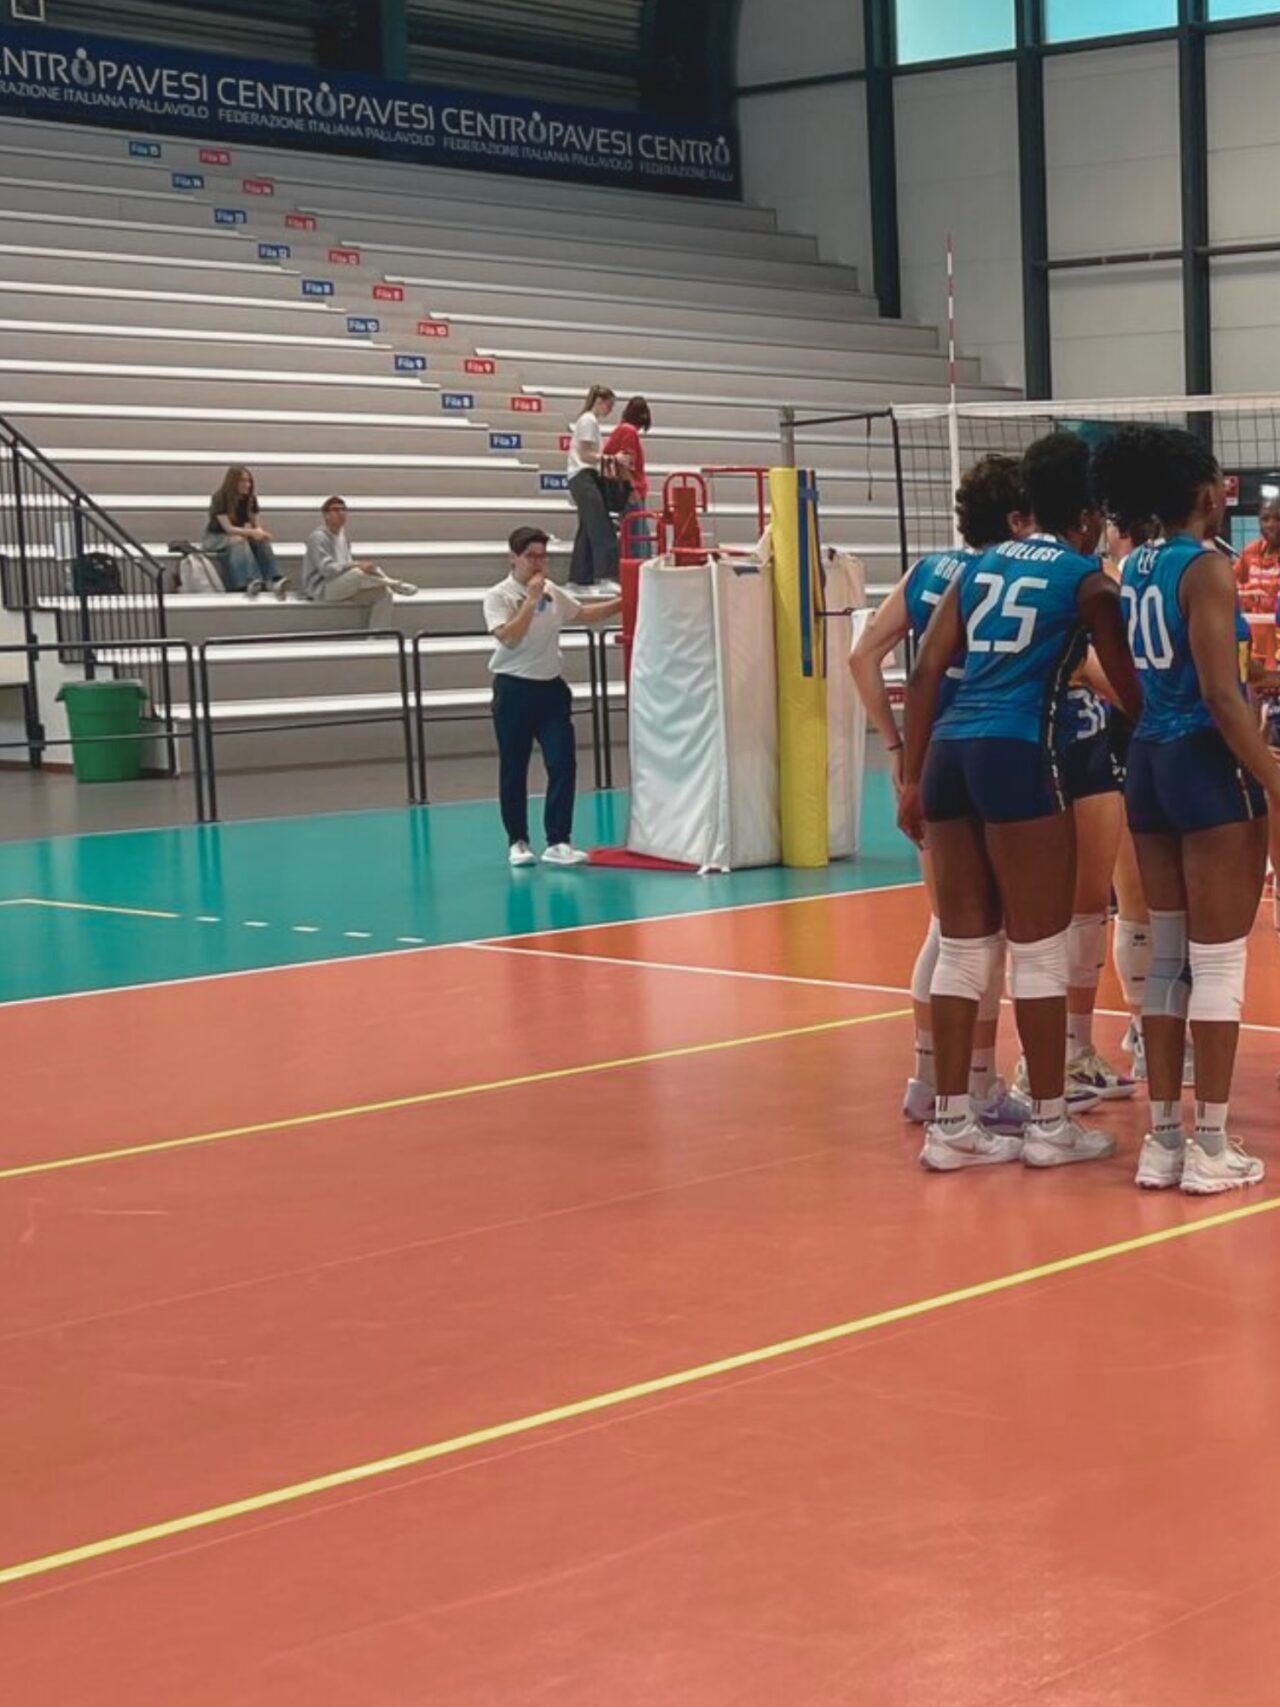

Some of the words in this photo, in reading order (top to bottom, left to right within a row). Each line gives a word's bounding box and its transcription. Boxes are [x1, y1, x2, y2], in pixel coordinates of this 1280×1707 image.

[0, 46, 208, 101] NTROPAVESI
[217, 77, 435, 130] CENTROPAVESI
[442, 107, 632, 157] CENTROPAVESI
[638, 134, 731, 166] CENTRO
[0, 79, 61, 101] RAZIONE
[64, 89, 126, 109] ITALIANA
[129, 97, 209, 119] PALLAVOLO
[218, 108, 304, 132] FEDERAZIONE
[308, 119, 363, 138] ITALIANA
[366, 127, 434, 147] PALLAVOLO
[350, 319, 366, 330] Fila
[420, 324, 435, 335] Fila
[398, 357, 415, 368] Fila
[415, 357, 422, 369] 9
[468, 361, 484, 371] Fila
[484, 362, 491, 372] 9
[445, 396, 462, 407] Fila
[514, 400, 530, 410] Fila
[493, 435, 510, 446] Fila
[511, 436, 518, 447] 7
[544, 475, 560, 489] Fila
[966, 572, 1049, 654] 25
